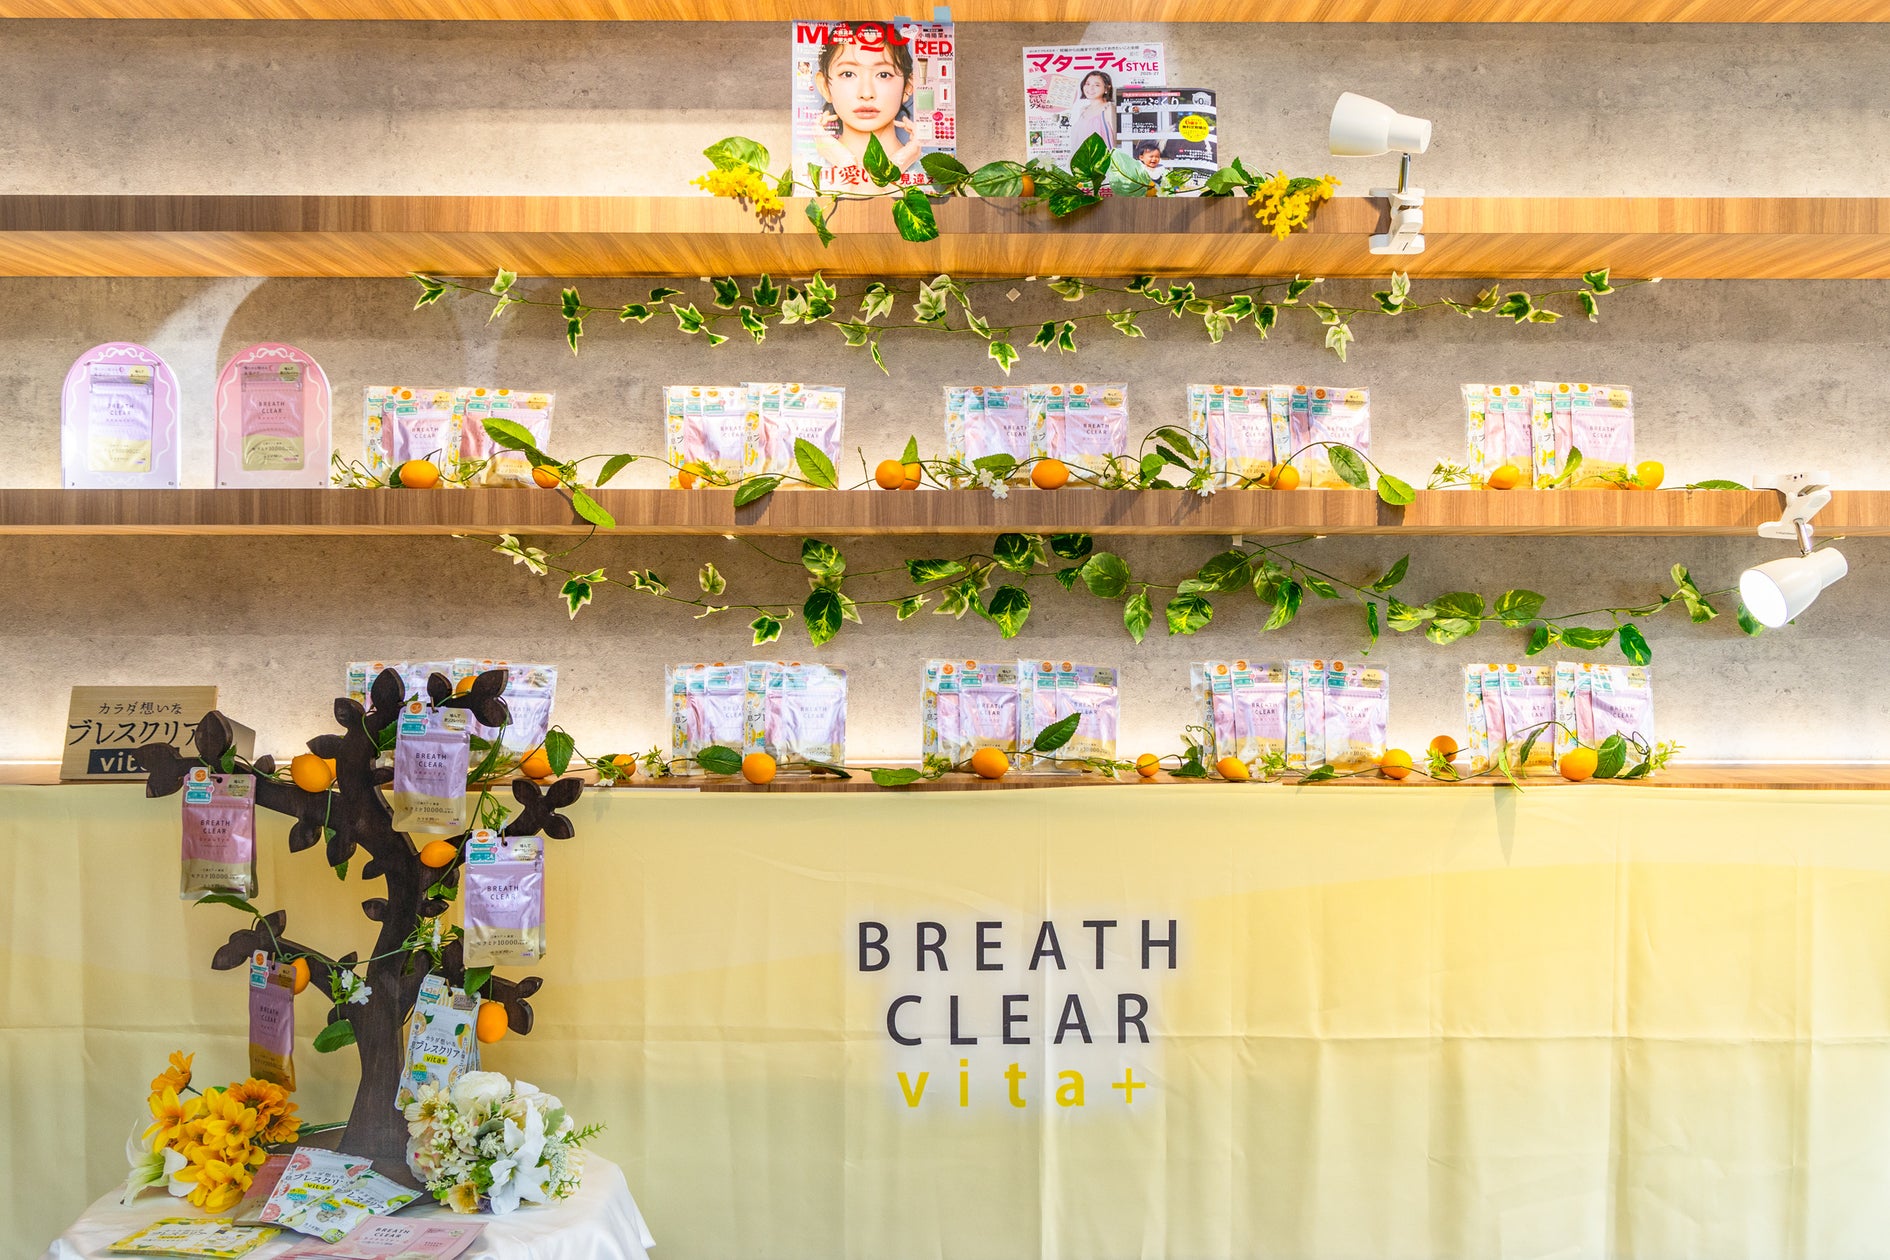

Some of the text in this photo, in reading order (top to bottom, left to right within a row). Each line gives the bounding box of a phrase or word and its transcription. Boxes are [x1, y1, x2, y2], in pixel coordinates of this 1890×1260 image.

[915, 41, 952, 54] RED
[1026, 52, 1158, 72] マタニティ STYLE
[98, 702, 182, 716] カラダ想いな
[100, 752, 148, 772] vit
[858, 920, 1176, 972] BREATH
[886, 993, 1150, 1046] CLEAR
[416, 1041, 460, 1058] ブレスクリア
[426, 1055, 446, 1064] vita+
[897, 1059, 1146, 1107] vita+
[293, 1174, 343, 1186] ブレスクリ
